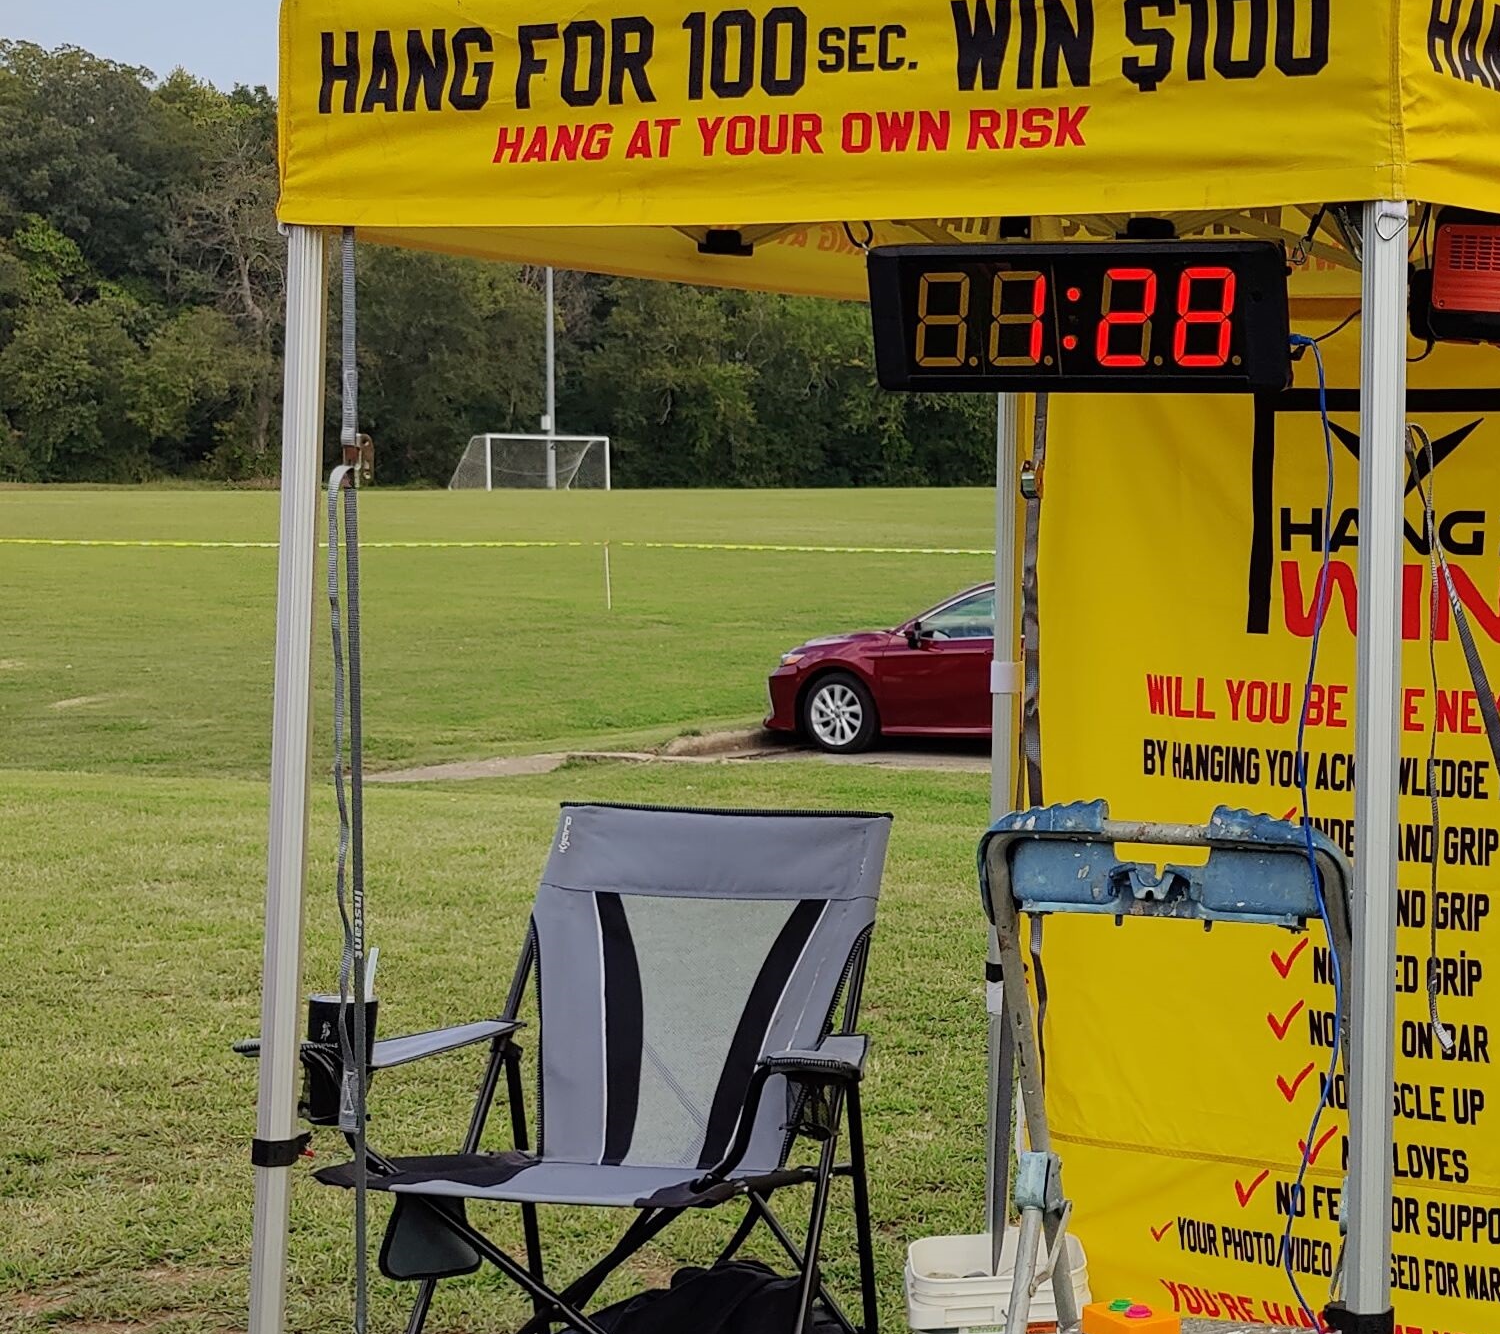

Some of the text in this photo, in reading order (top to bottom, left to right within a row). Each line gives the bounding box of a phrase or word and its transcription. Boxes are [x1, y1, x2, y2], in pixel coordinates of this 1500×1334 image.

[318, 28, 495, 114] HANG
[515, 17, 657, 109] FOR
[681, 7, 807, 101] 100
[818, 24, 918, 73] SEC.
[492, 106, 1092, 163] HANG AT YOUR OWN RISK
[1146, 674, 1216, 720] WILL
[1226, 679, 1292, 725] YOU
[1303, 684, 1349, 728] BE
[1143, 739, 1168, 777] BY
[1172, 741, 1260, 786] HANGING
[1266, 749, 1309, 788] YOU
[1443, 826, 1499, 867] GRIP
[353, 890, 365, 960] Instant
[1436, 891, 1490, 932] GRIP
[1308, 1009, 1491, 1064] NO ON BAR
[1319, 1071, 1348, 1110] NO
[1452, 1087, 1485, 1126] UP
[1392, 1141, 1470, 1184] LOVES
[1275, 1180, 1306, 1218] NO
[1391, 1195, 1421, 1235] OR
[1177, 1216, 1220, 1257] YOUR
[1221, 1225, 1333, 1278] PHOTO/VIDEO
[1424, 1258, 1461, 1299] FOR
